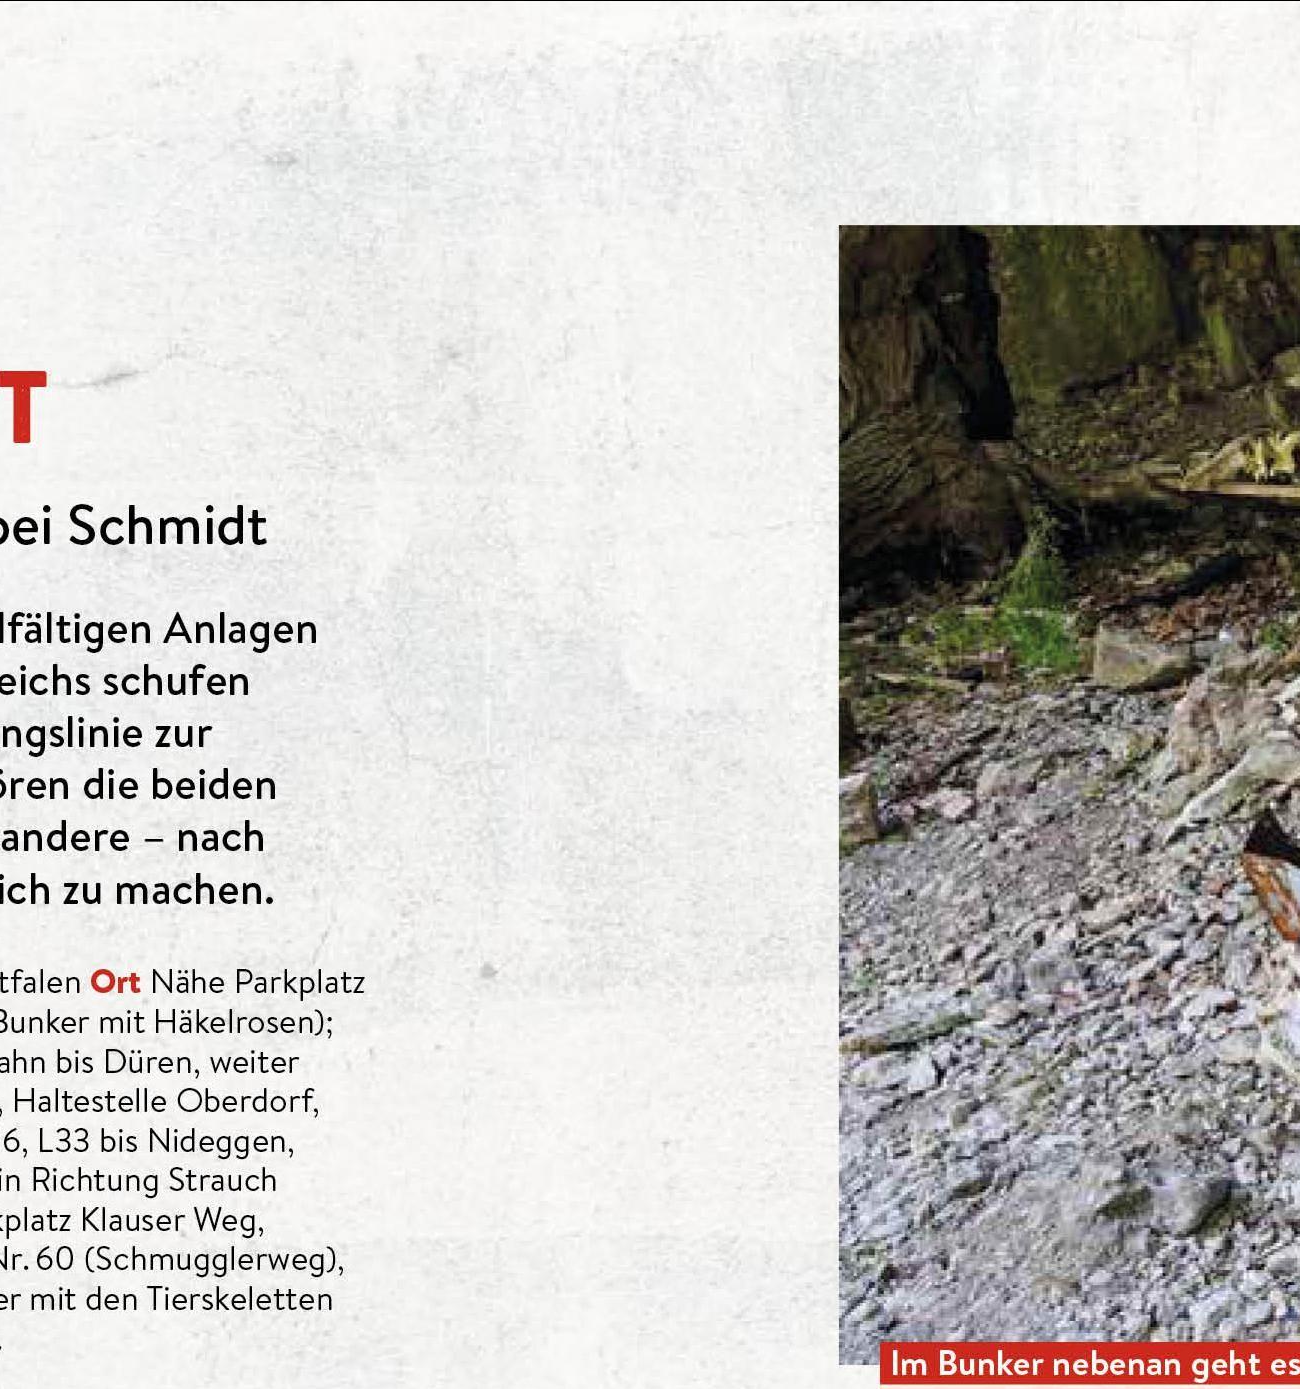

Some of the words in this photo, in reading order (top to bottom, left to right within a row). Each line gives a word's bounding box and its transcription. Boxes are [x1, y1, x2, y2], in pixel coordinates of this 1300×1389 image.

[70, 504, 267, 545] Schmidt
[163, 612, 316, 653] Anlagen
[156, 726, 212, 747] zur
[84, 768, 138, 799] die
[153, 768, 275, 799] beiden
[64, 883, 101, 904] zu
[117, 873, 273, 904] machen.
[91, 969, 140, 993] Ort
[153, 969, 224, 993] Nähe
[237, 969, 365, 1001] Parkplatz
[57, 1049, 93, 1073] bis
[106, 1049, 199, 1079] Düren,
[210, 1050, 299, 1073] weiter
[893, 1350, 926, 1375] Im
[940, 1350, 1044, 1375] Bunker
[1054, 1350, 1180, 1375] nebenan
[1192, 1350, 1260, 1383] geht
[1271, 1359, 1300, 1375] es
